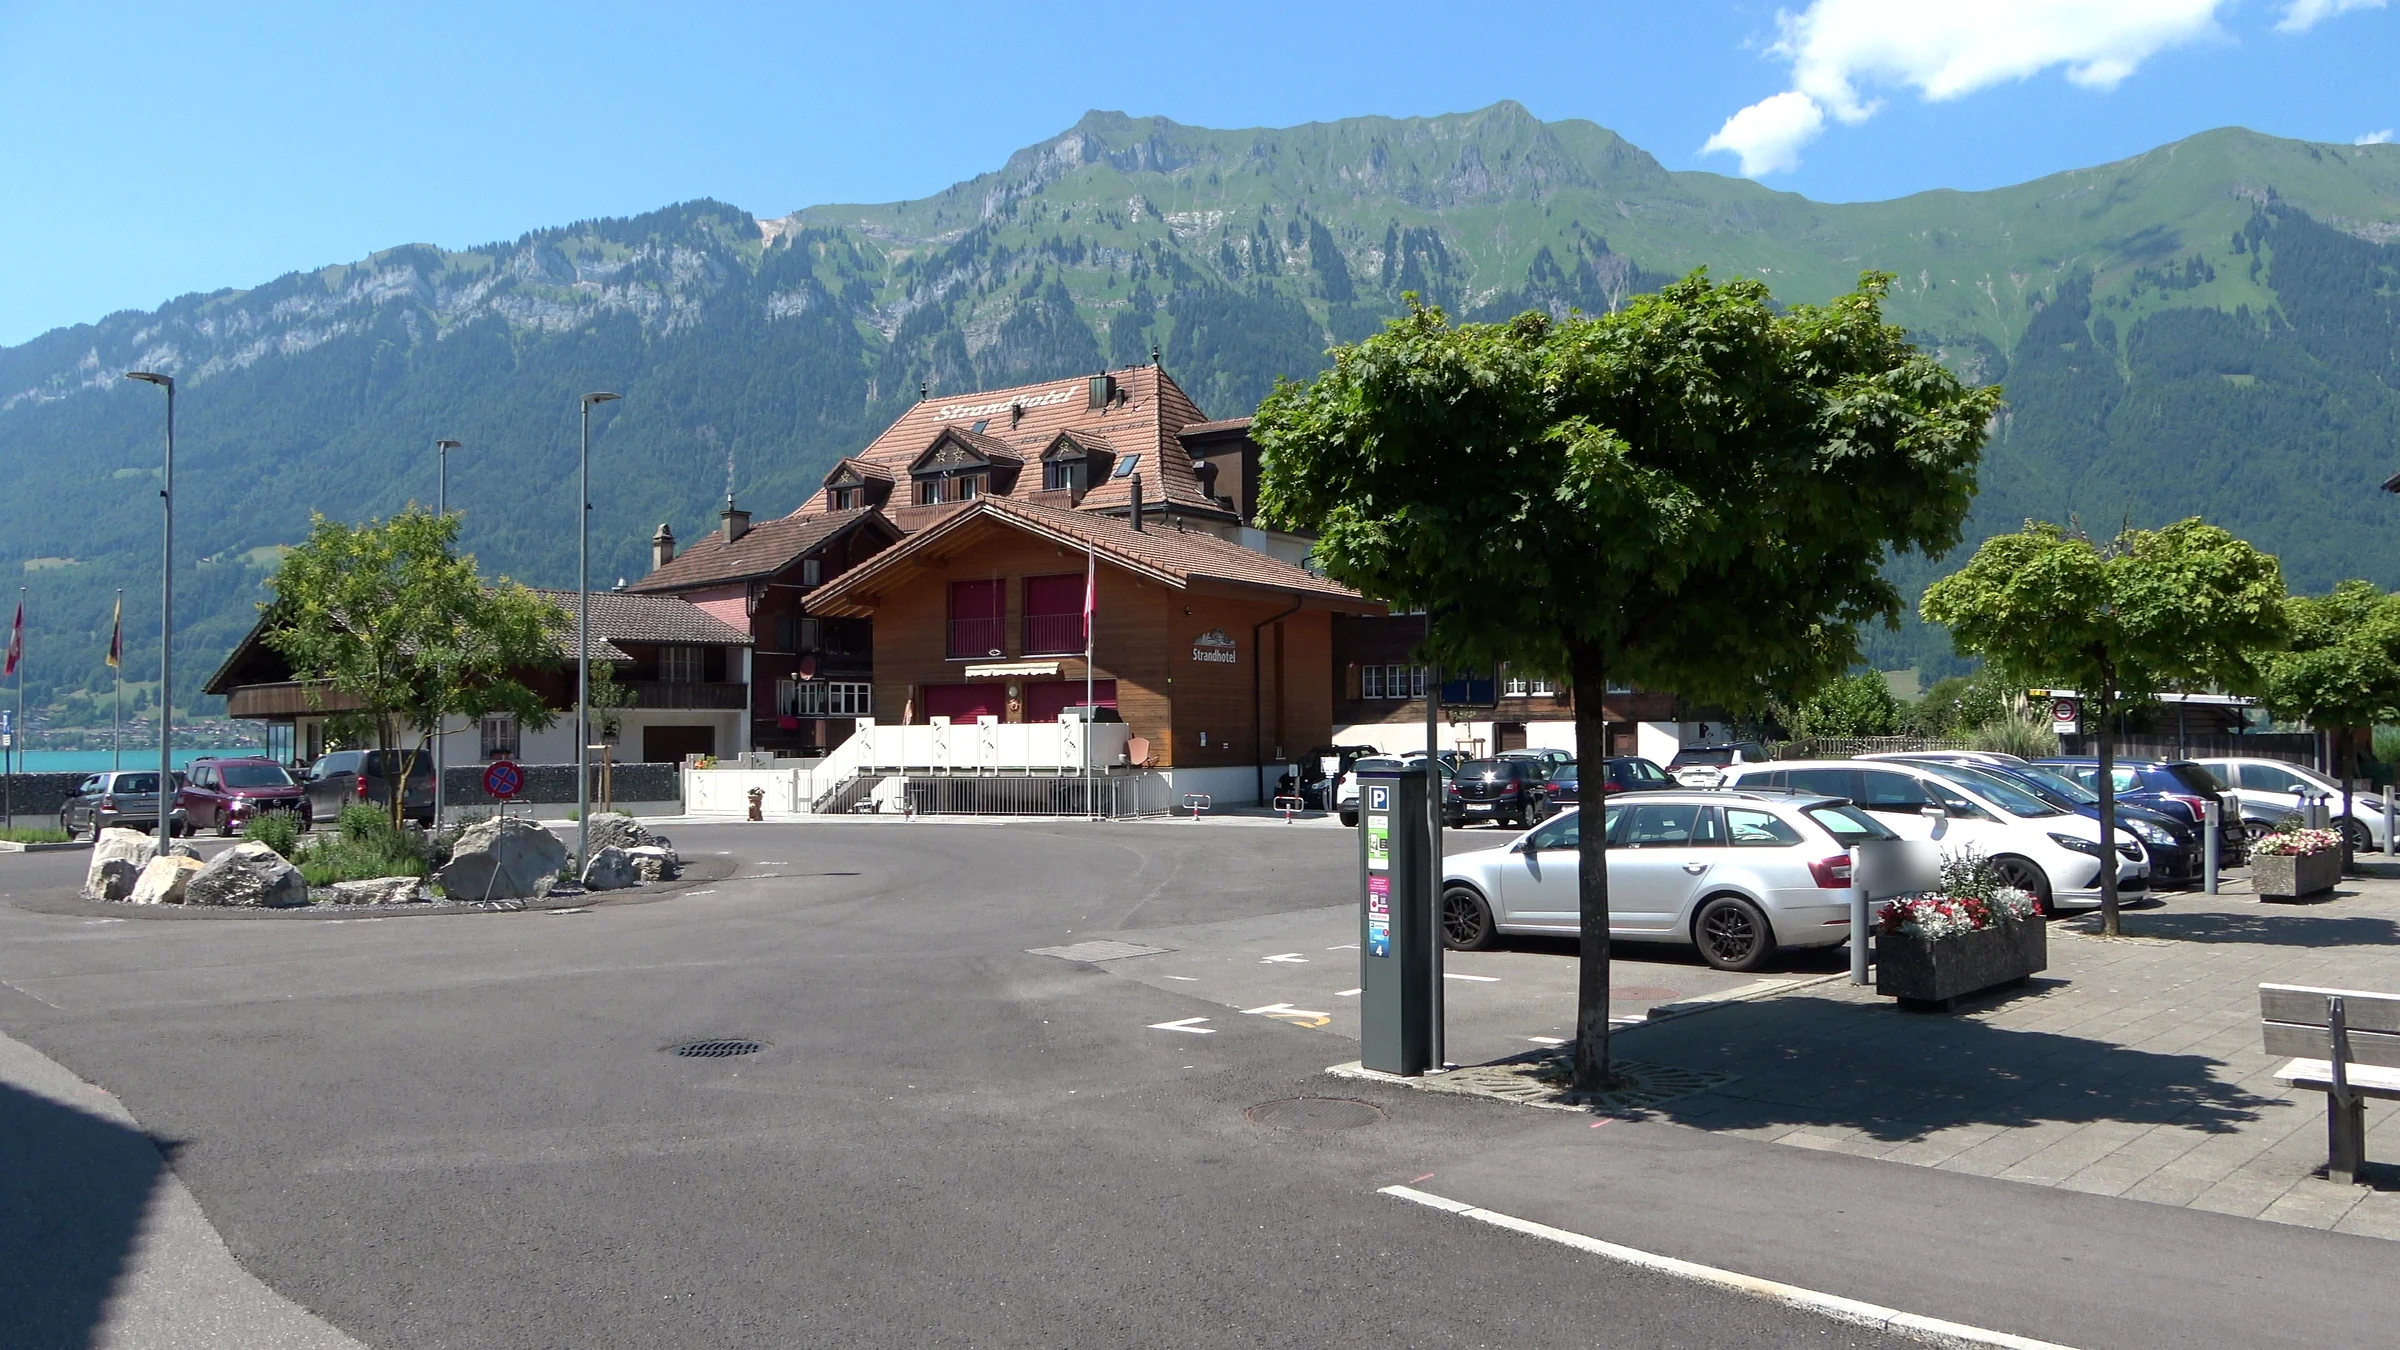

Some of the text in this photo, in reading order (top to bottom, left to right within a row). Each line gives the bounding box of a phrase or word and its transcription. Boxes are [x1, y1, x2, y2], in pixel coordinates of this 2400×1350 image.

[933, 386, 1080, 421] Strandhotel
[1193, 648, 1236, 663] Strandhotel
[1373, 789, 1385, 808] P
[1376, 945, 1383, 957] 4
